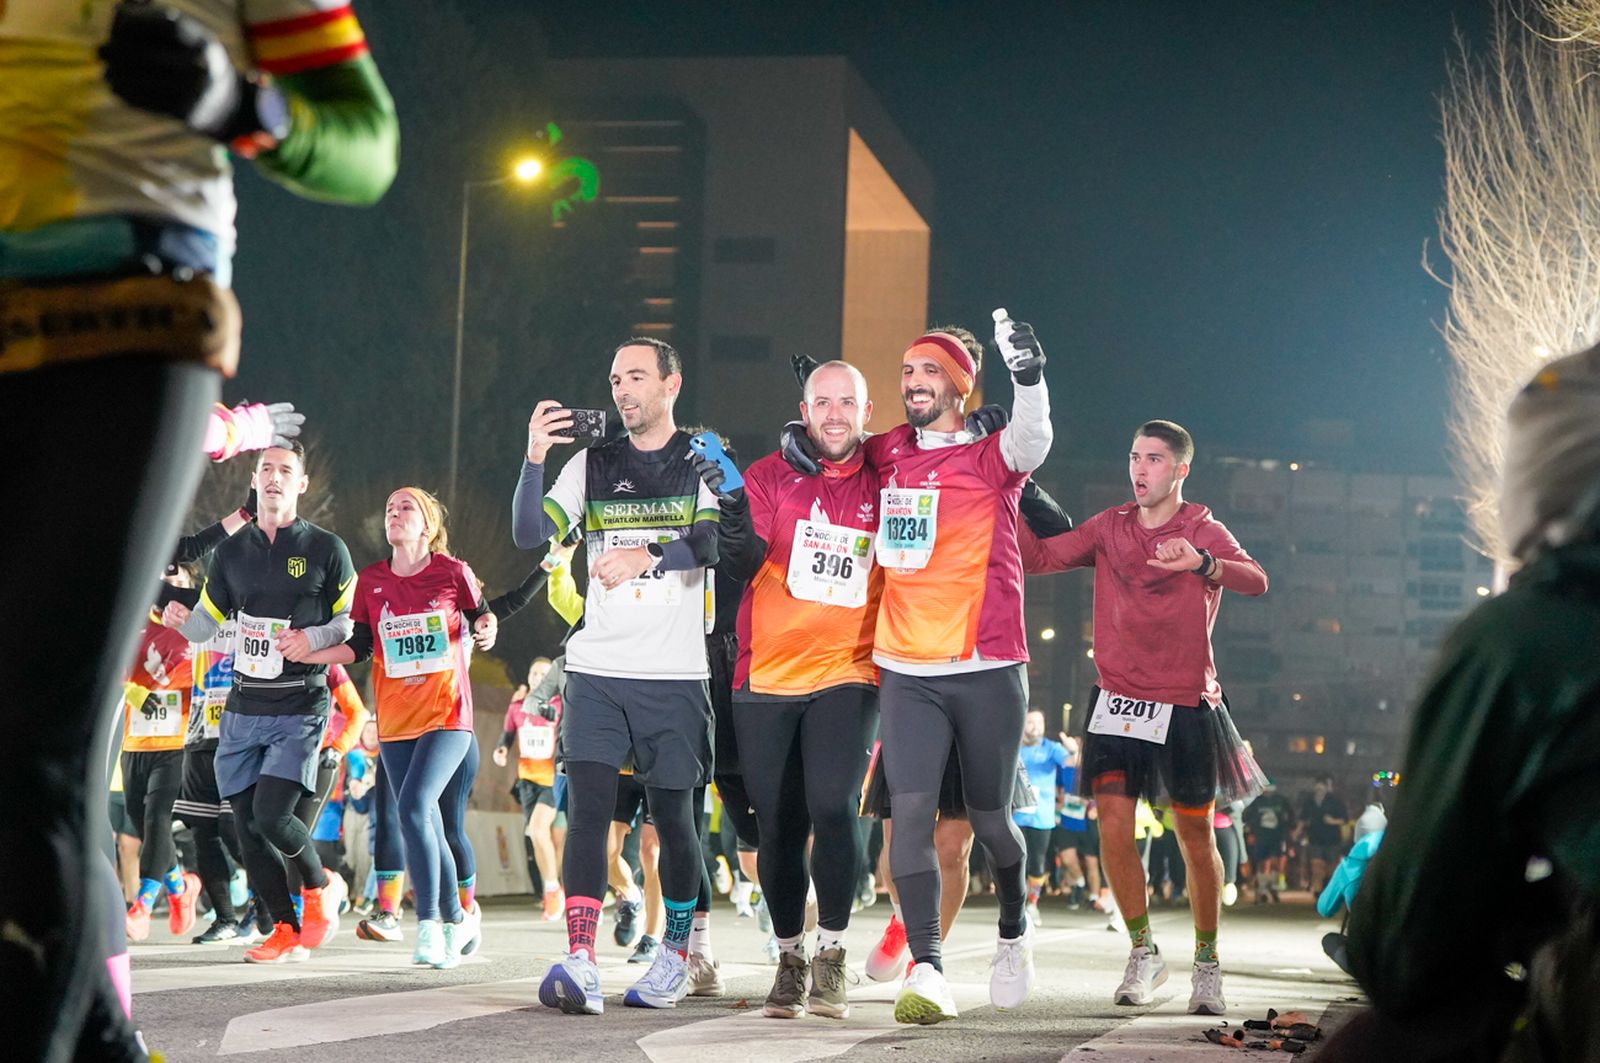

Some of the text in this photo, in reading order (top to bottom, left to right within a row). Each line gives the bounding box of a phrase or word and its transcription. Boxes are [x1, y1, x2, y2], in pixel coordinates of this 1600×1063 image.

[603, 500, 685, 517] SERMAN
[642, 514, 685, 523] MARBELLA
[887, 517, 928, 541] 13234
[619, 538, 639, 546] NOCHE
[802, 539, 820, 549] SAN
[812, 551, 853, 580] 396
[394, 620, 413, 629] NOCHE
[387, 629, 401, 638] SAN
[244, 636, 270, 657] 609
[395, 635, 436, 656] 7982
[1109, 697, 1157, 720] 3201
